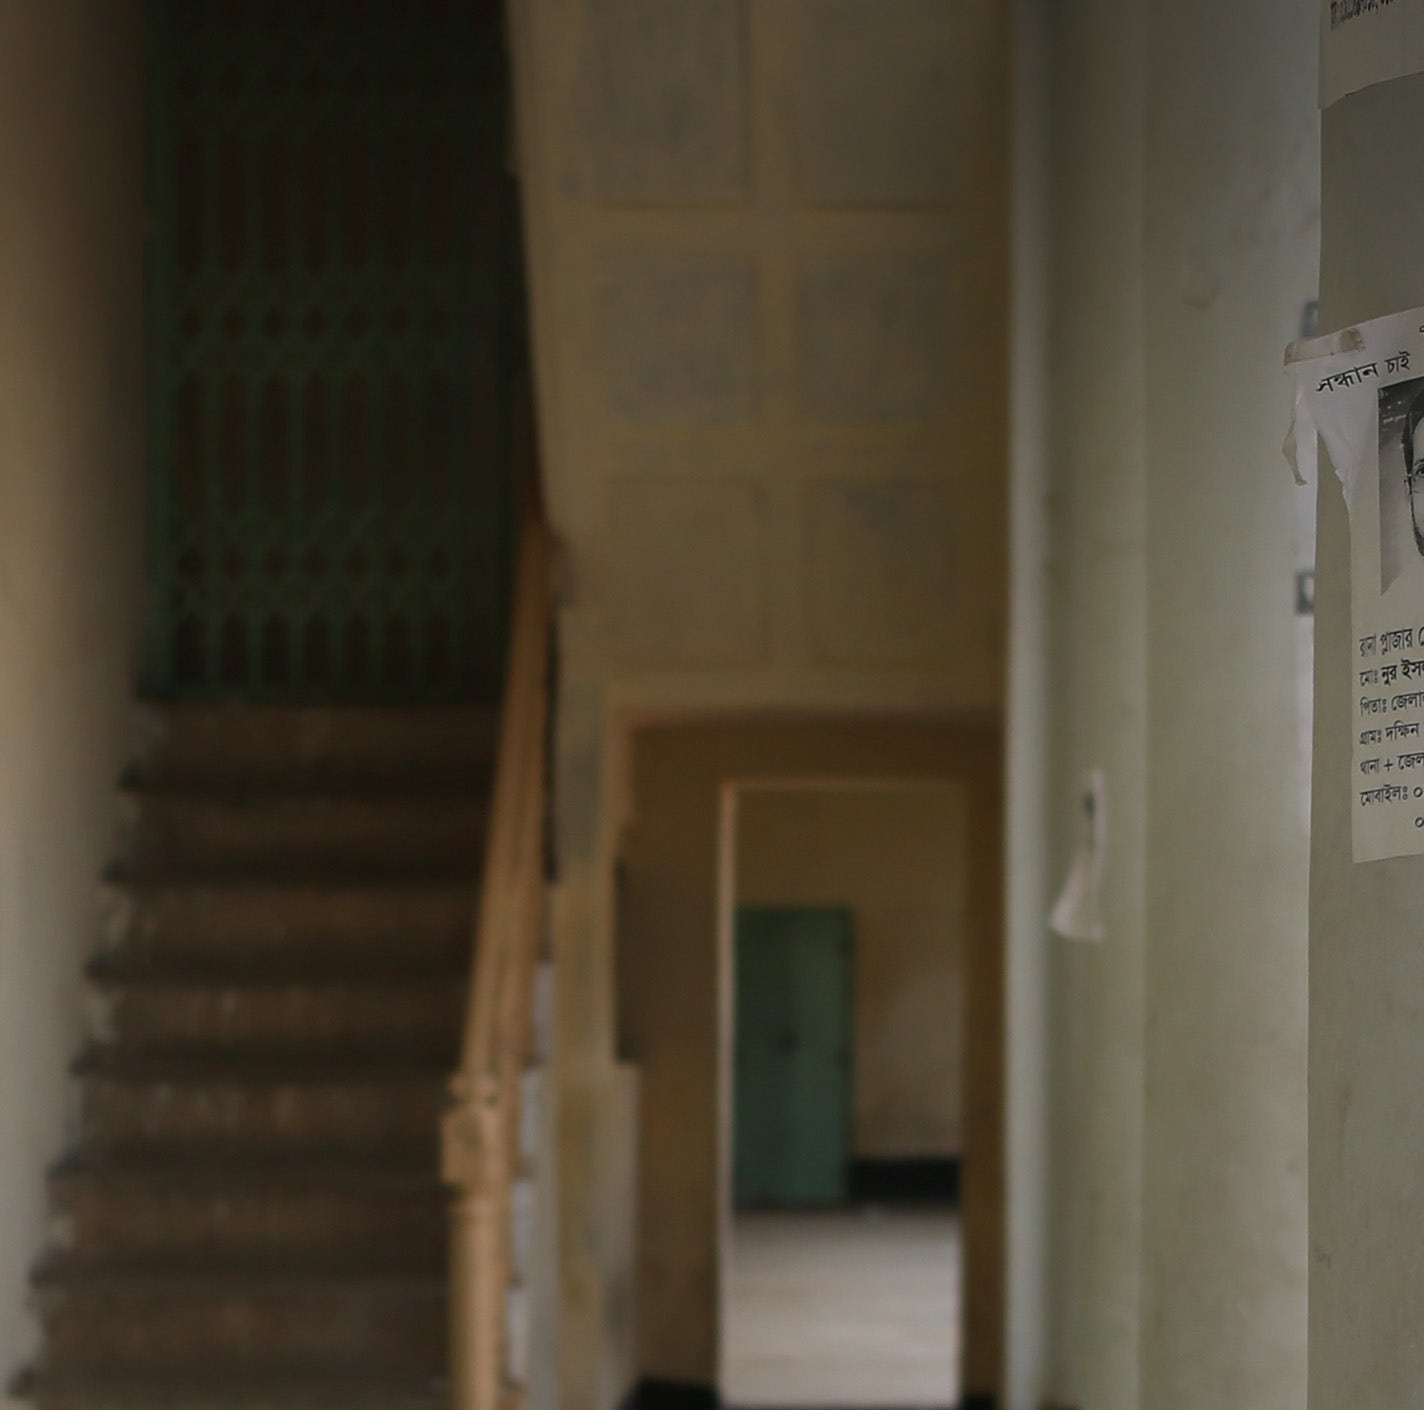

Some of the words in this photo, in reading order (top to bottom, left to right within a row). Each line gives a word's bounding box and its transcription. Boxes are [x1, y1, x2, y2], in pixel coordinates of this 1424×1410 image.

[1316, 362, 1380, 394] সন্ধান
[1384, 351, 1411, 373] চাই
[1381, 664, 1397, 686] নুর
[1360, 696, 1387, 717] পিতাঃ
[1385, 720, 1420, 740] দক্ষিন
